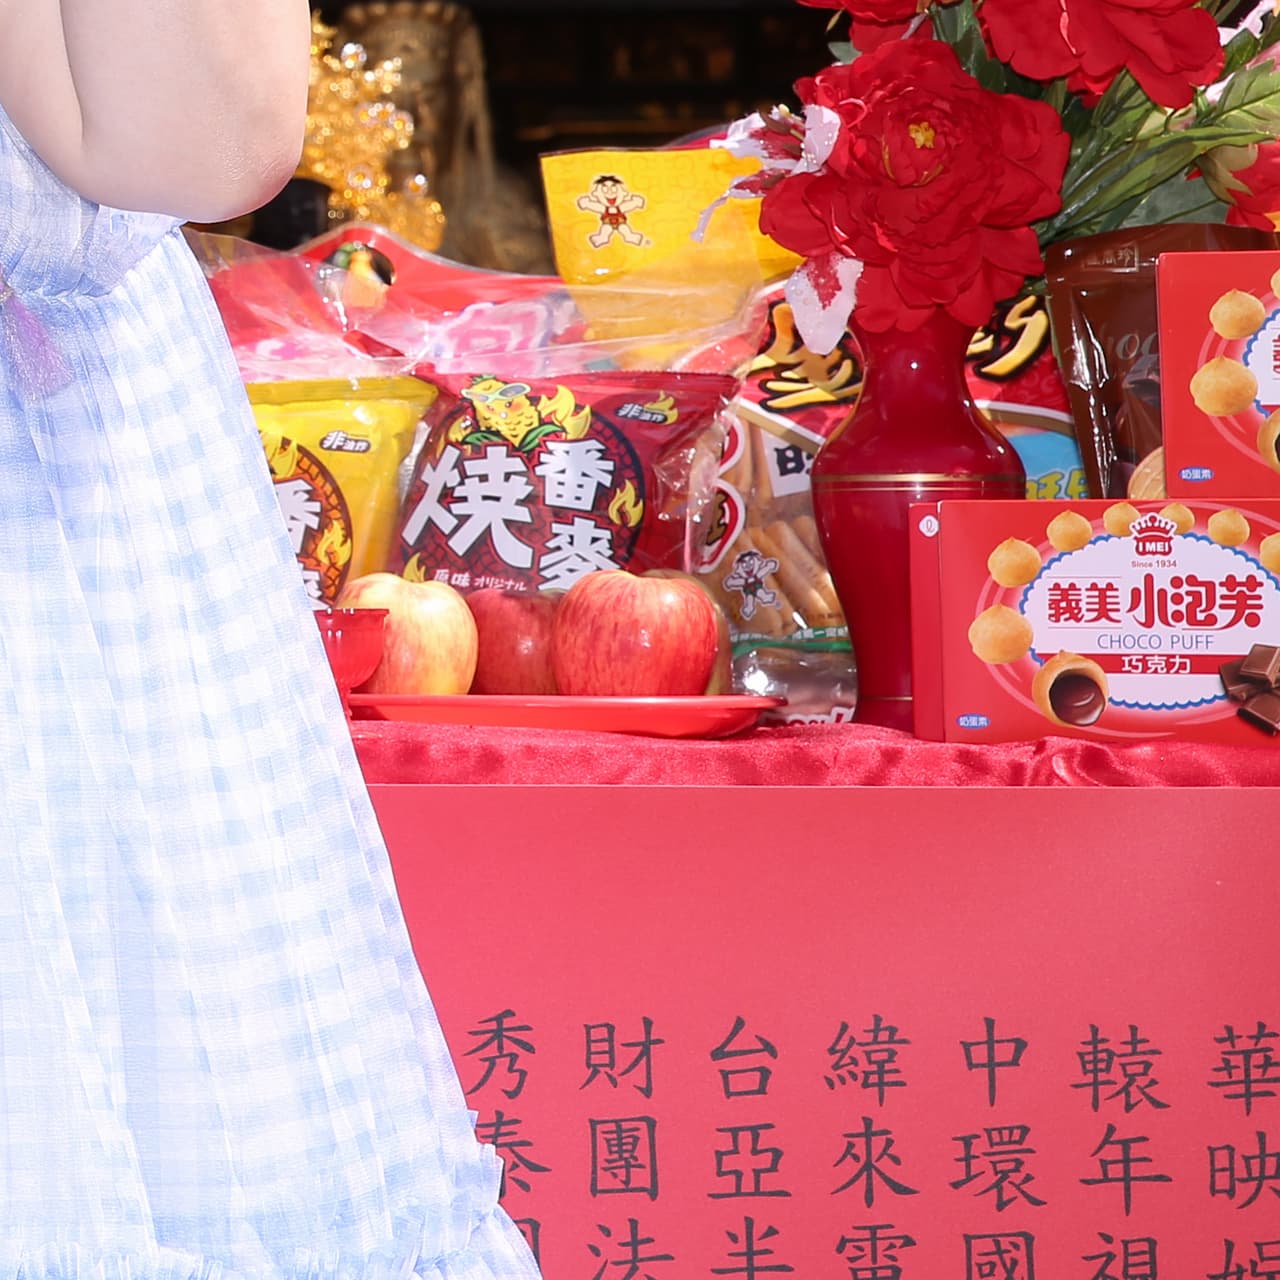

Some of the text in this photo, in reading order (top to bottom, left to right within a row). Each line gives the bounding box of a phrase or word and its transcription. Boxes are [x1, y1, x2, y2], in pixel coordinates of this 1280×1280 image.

[1145, 541, 1169, 553] MEI
[1131, 560, 1177, 568] Since 1934
[1097, 633, 1215, 651] CHOCO PUFF
[1121, 655, 1191, 674] 巧克力
[580, 1016, 675, 1279] 財團法
[707, 1016, 794, 1279] 台亞半
